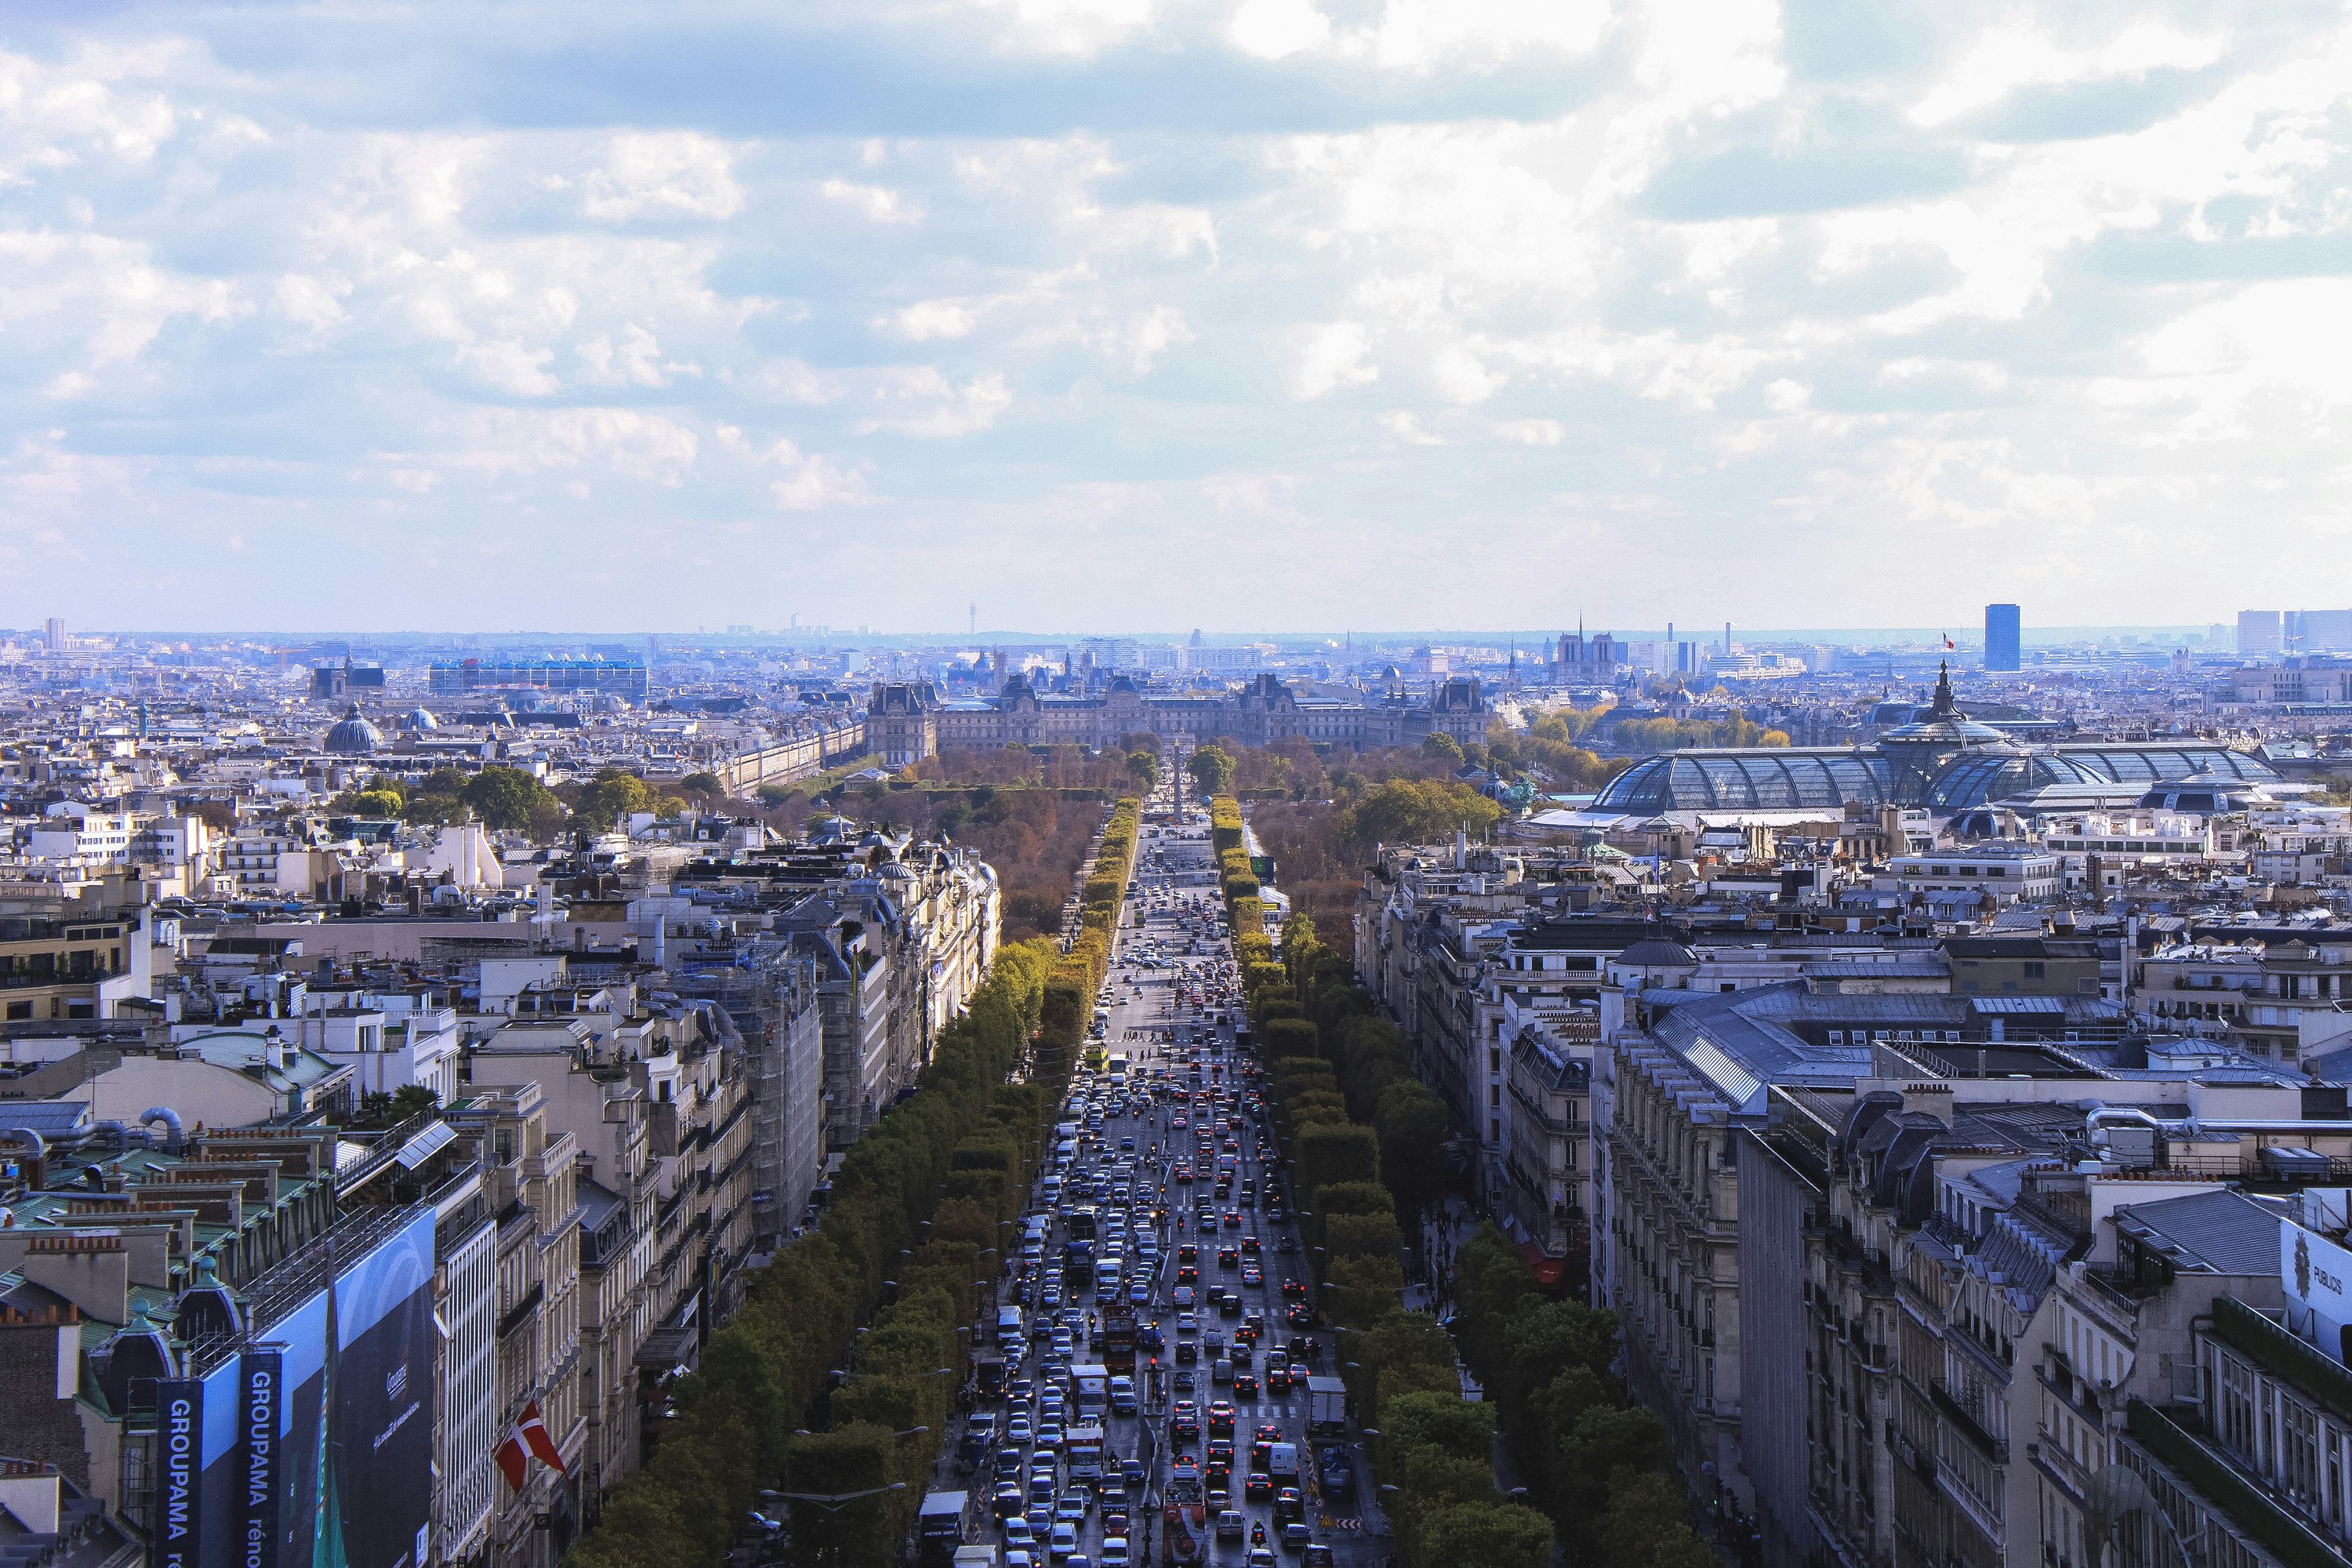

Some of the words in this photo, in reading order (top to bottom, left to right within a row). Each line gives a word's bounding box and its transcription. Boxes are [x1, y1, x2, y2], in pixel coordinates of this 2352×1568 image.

[2314, 1266, 2342, 1295] PUBLICIS
[168, 1399, 191, 1540] GROUPAMA
[249, 1371, 271, 1506] GROUPAMA
[246, 1519, 266, 1568] réno
